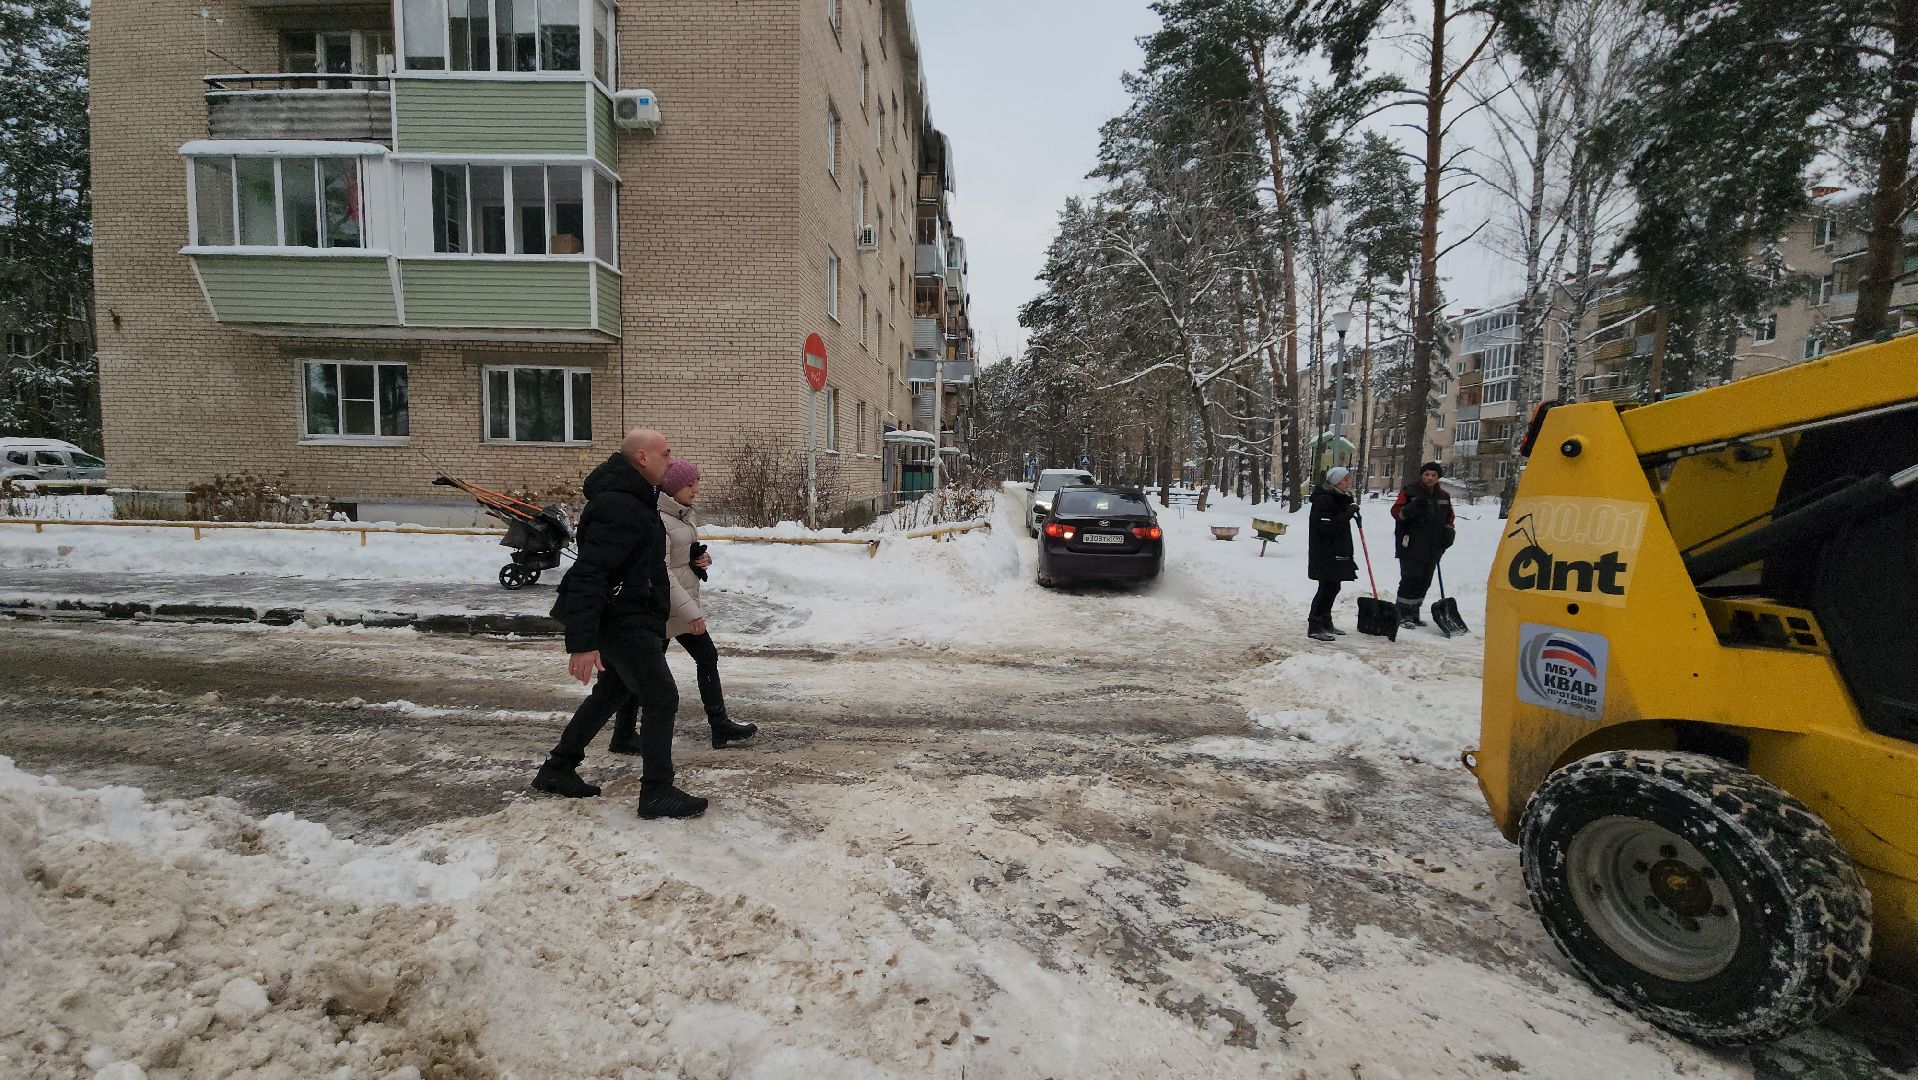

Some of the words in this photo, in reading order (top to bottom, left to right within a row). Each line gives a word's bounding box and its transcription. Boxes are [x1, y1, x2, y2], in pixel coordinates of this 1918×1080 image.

[1508, 544, 1627, 595] ant
[1545, 662, 1578, 678] МБУ
[1544, 674, 1598, 697] КВАР
[1547, 688, 1597, 706] ПРОТВИНО
